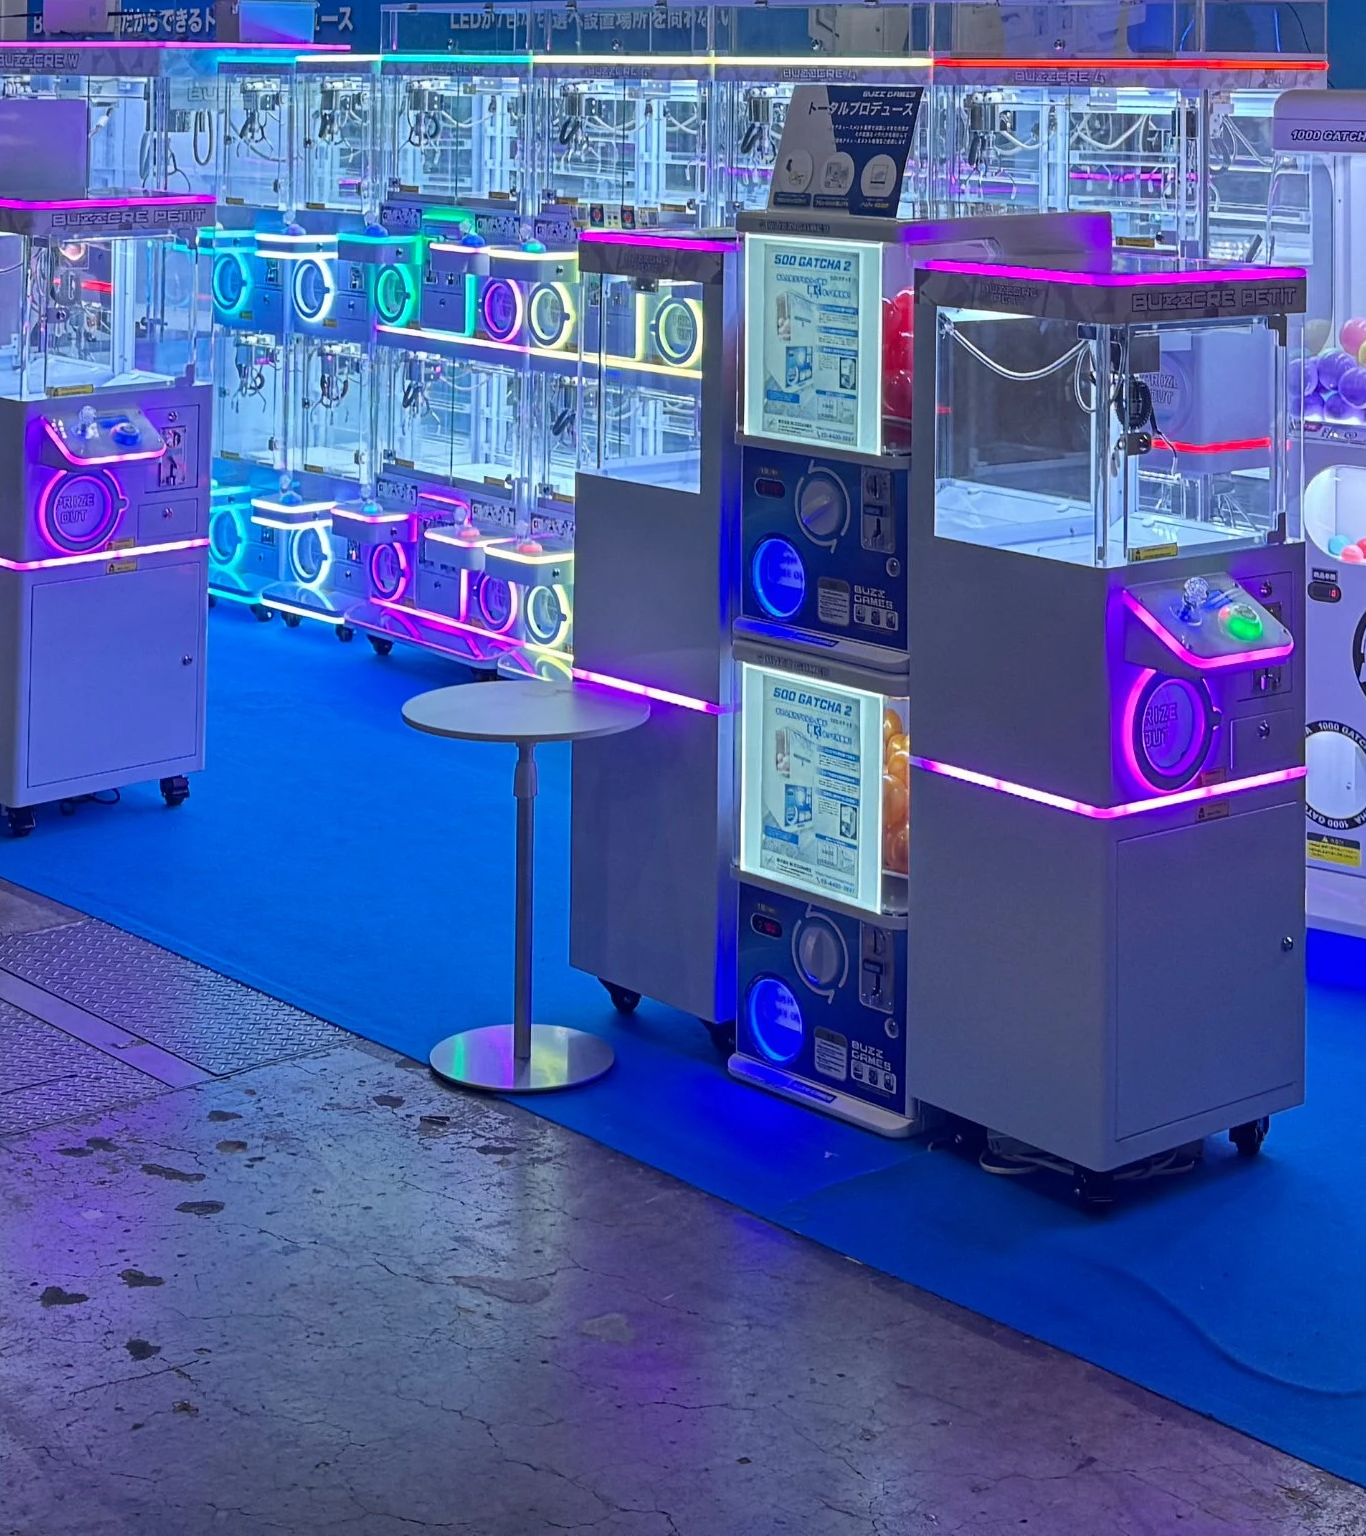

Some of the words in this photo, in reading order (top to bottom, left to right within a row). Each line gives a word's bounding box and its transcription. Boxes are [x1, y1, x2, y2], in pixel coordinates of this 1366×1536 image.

[64, 54, 80, 69] W
[808, 102, 914, 117] トータルプロデュース
[1291, 128, 1321, 141] 1000
[51, 210, 150, 227] BUZZCRE
[153, 208, 206, 224] PETIT
[774, 254, 797, 266] 500
[798, 255, 842, 272] GATCHA
[843, 261, 852, 272] 2
[1132, 289, 1235, 312] BUZZCRE
[1241, 286, 1297, 307] PETIT
[57, 492, 96, 509] PRIZE
[61, 509, 89, 525] OUT
[854, 585, 887, 597] BUZZ
[854, 594, 894, 610] GAMES
[773, 687, 797, 702] 500
[798, 693, 843, 715] GATCHA
[843, 705, 853, 717] 2
[1143, 702, 1178, 725] RIZE
[1318, 722, 1340, 732] 1000
[1327, 819, 1350, 830] 1000
[851, 1039, 885, 1059] BUZZ
[851, 1050, 892, 1072] GAMES
